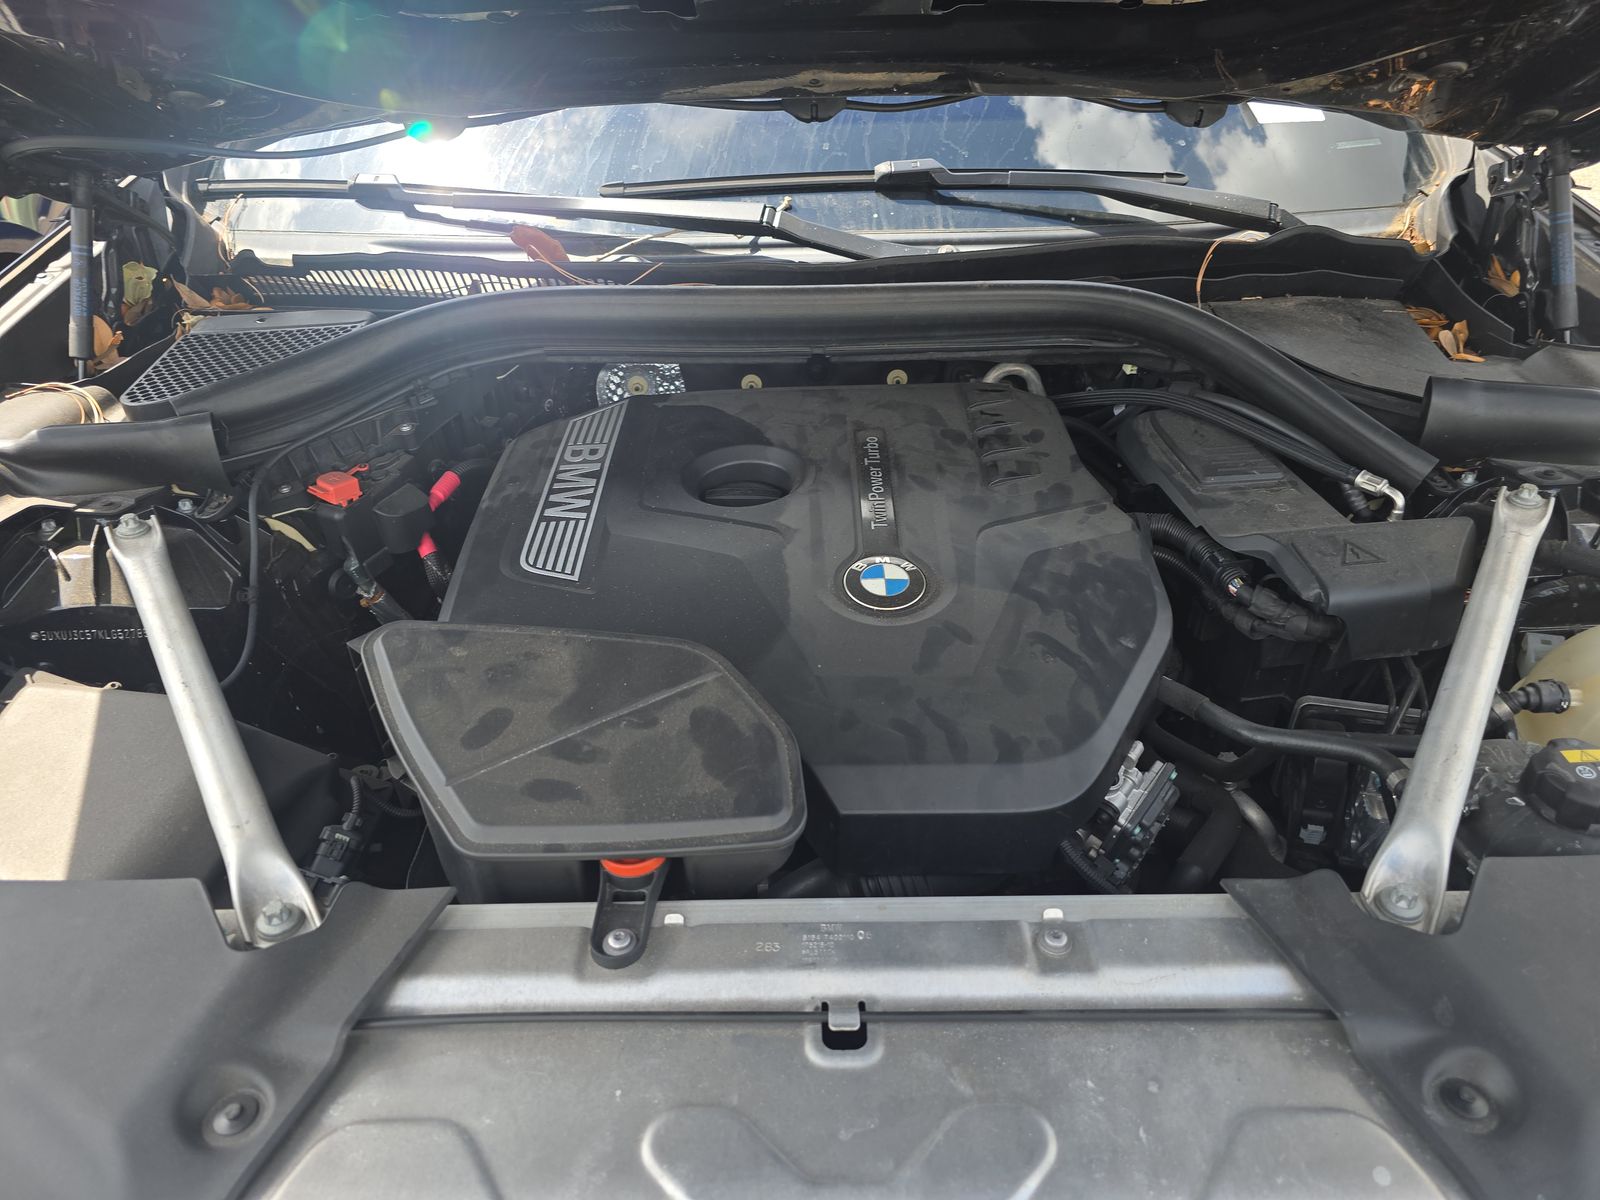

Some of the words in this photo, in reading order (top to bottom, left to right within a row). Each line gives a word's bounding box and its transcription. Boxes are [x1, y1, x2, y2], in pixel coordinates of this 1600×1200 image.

[863, 436, 881, 465] Turbo
[543, 443, 608, 520] BMW
[868, 466, 889, 530] TwinPower
[851, 556, 917, 572] BMW
[755, 942, 781, 952] 283
